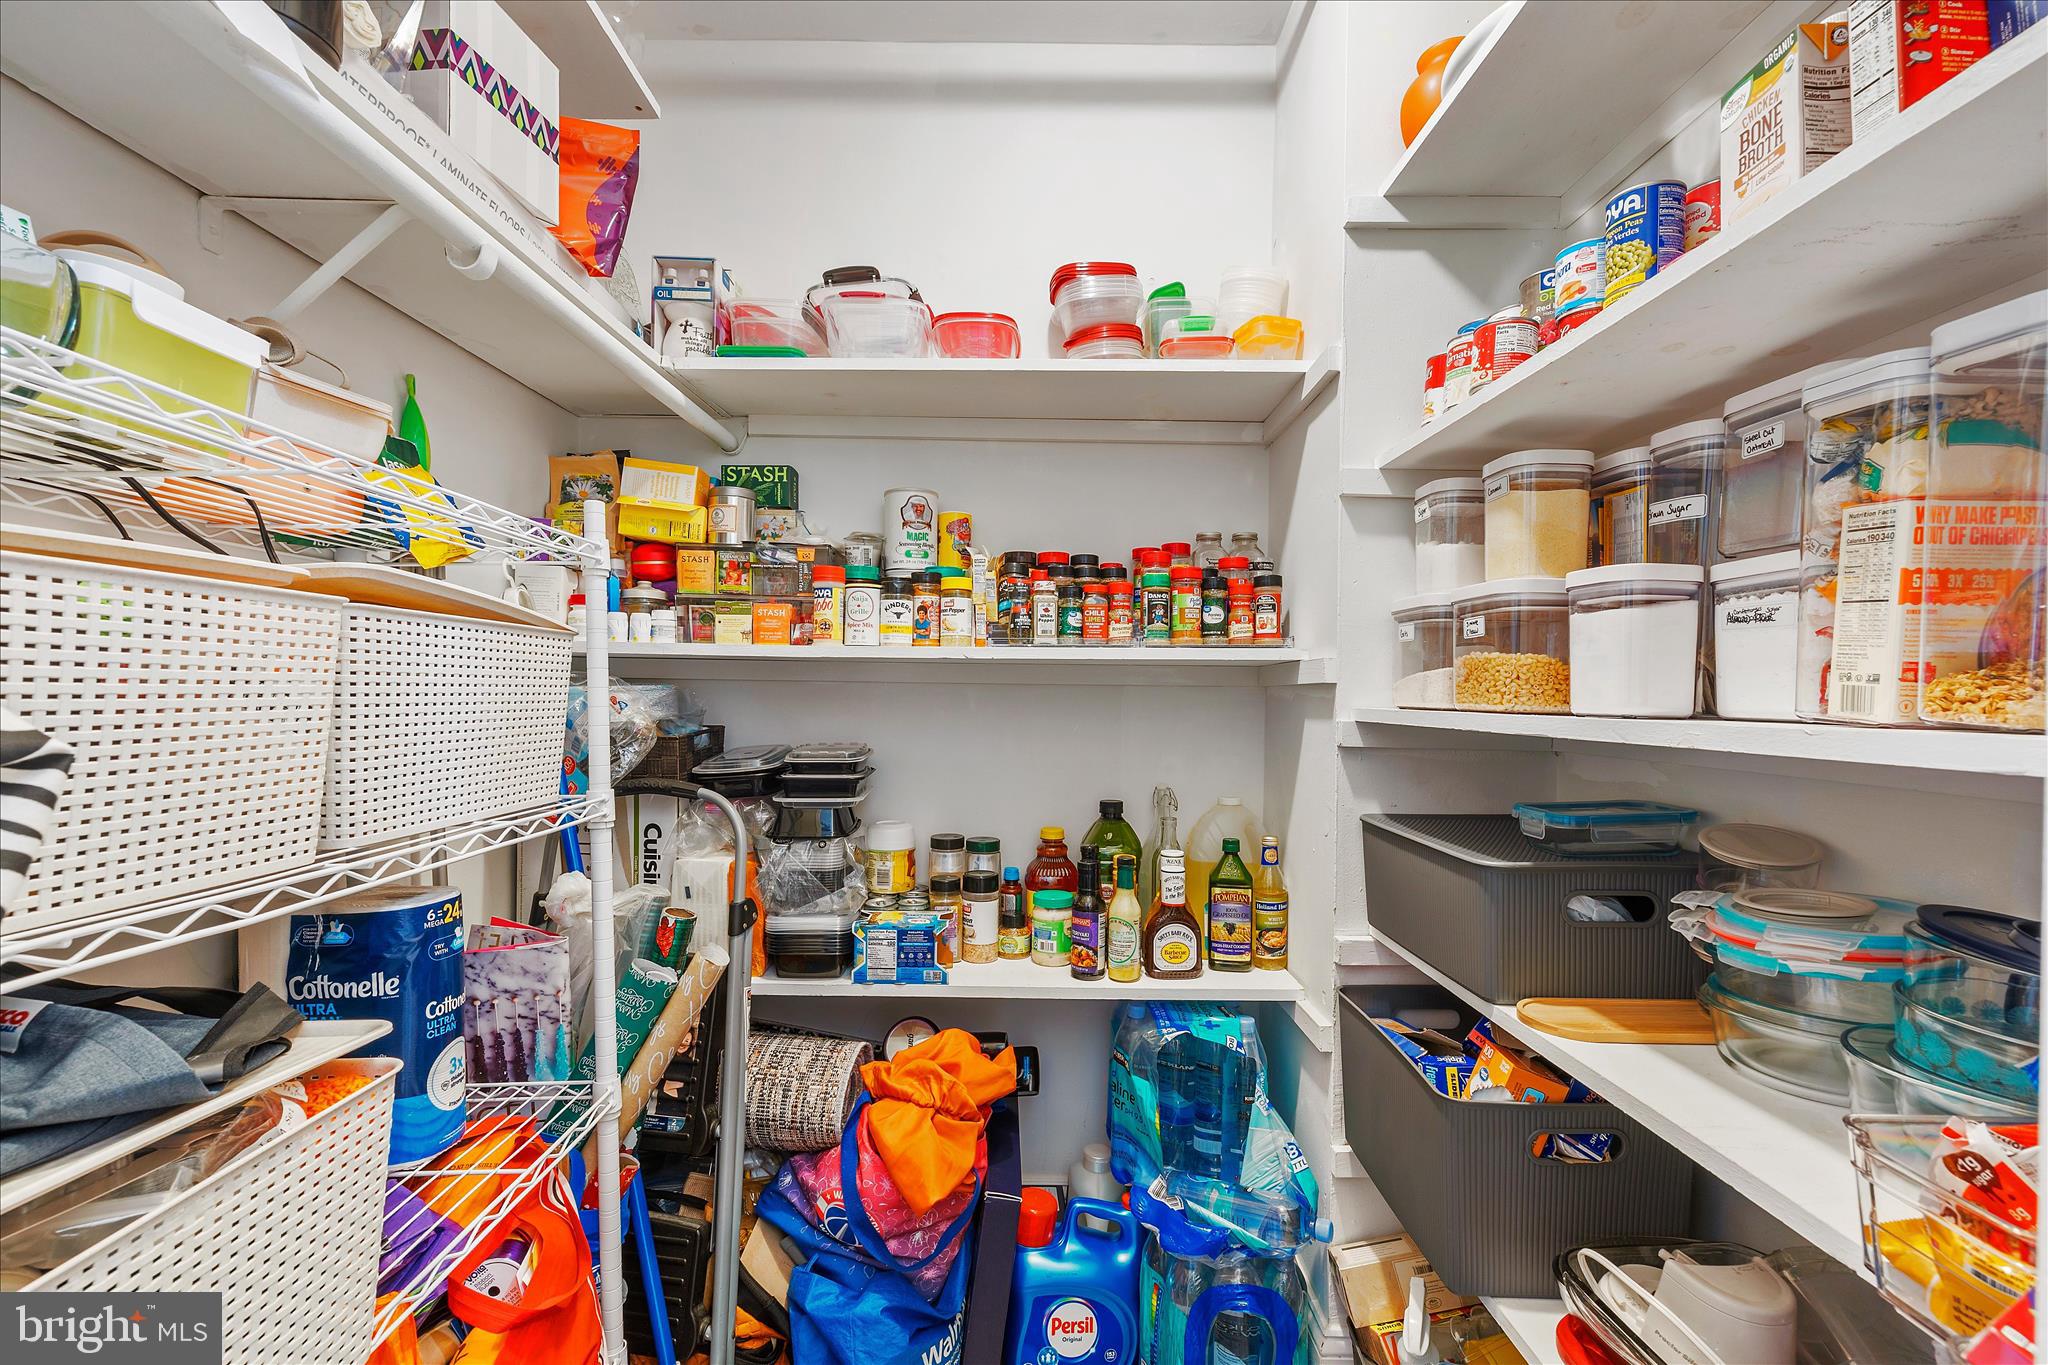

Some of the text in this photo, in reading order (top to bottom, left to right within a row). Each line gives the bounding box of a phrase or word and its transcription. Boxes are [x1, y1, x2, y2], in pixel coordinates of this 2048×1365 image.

[1764, 33, 1794, 69] ORGANIC
[1742, 88, 1781, 129] CHICKEN
[1740, 102, 1783, 155] BONE
[1738, 124, 1783, 175] BROTH
[1624, 218, 1644, 228] Peas
[656, 290, 672, 298] OIL
[726, 466, 788, 482] STASH
[1667, 503, 1692, 518] Sugar
[1848, 508, 1896, 520] Nutrition Facts
[1954, 506, 1996, 524] MAKE
[906, 531, 928, 541] MAGIC
[1867, 534, 1880, 542] 190
[1880, 532, 1895, 540] 340
[814, 589, 832, 598] OYA
[758, 608, 786, 617] STASH
[1215, 893, 1249, 903] POMPEIAN
[427, 909, 435, 922] 6
[424, 920, 444, 930] MEGA
[288, 971, 400, 1000] Cottonelle
[425, 992, 466, 1020] Cottone
[426, 1014, 455, 1030] ULTRA
[426, 1022, 457, 1040] CLEAN
[450, 1056, 464, 1074] 3x
[1450, 1072, 1458, 1098] SLIDE
[1111, 1082, 1136, 1106] aline
[1051, 1317, 1094, 1336] Persil
